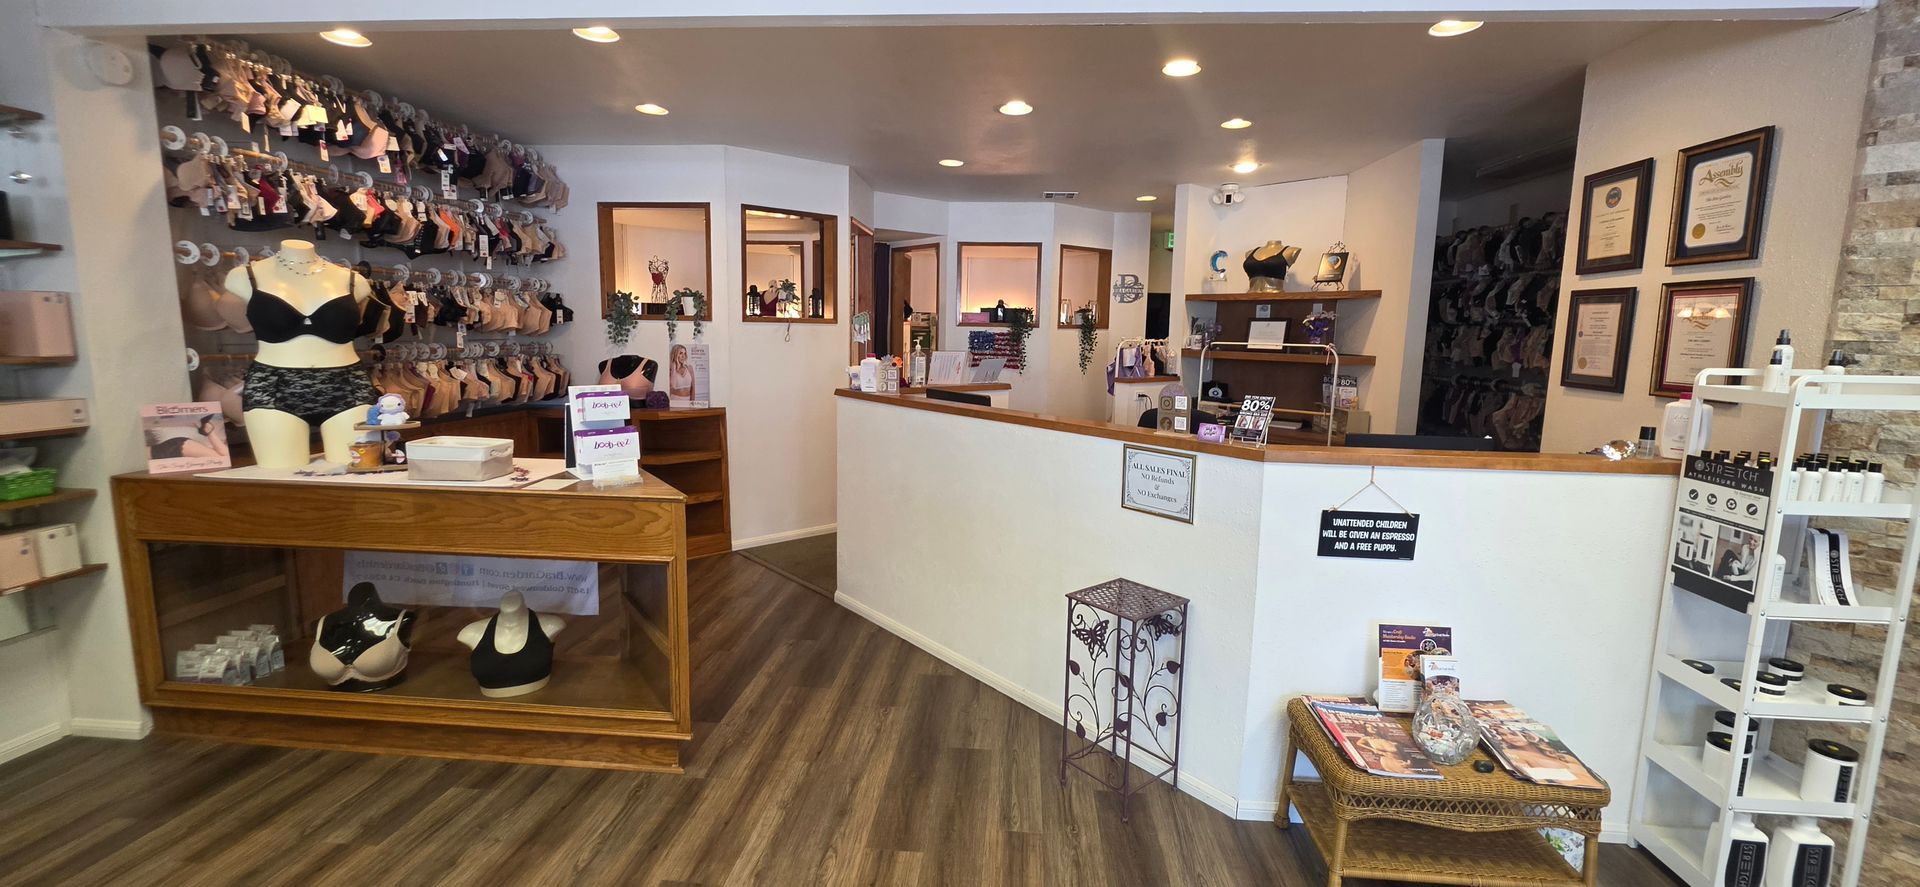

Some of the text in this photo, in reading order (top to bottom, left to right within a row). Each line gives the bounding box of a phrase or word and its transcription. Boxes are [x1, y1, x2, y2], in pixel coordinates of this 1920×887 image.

[1700, 161, 1743, 185] Assembly
[1242, 400, 1270, 411] 80%
[1132, 462, 1187, 479] ALL SALES FINAL
[1705, 462, 1760, 482] STRETCH
[1151, 476, 1175, 485] Refunds
[1688, 472, 1765, 493] ATHLEISURE WASH
[1147, 491, 1177, 503] Exchanges
[1333, 519, 1407, 529] UNATTENDED CHILDREN
[1322, 530, 1415, 541] WILL BE GIVEN AN ESPRESSO
[1334, 542, 1349, 550] AND
[1356, 543, 1372, 551] FREE
[1373, 544, 1397, 552] PUPPY.
[1831, 559, 1846, 601] STRETCH
[1835, 766, 1851, 801] STRETC
